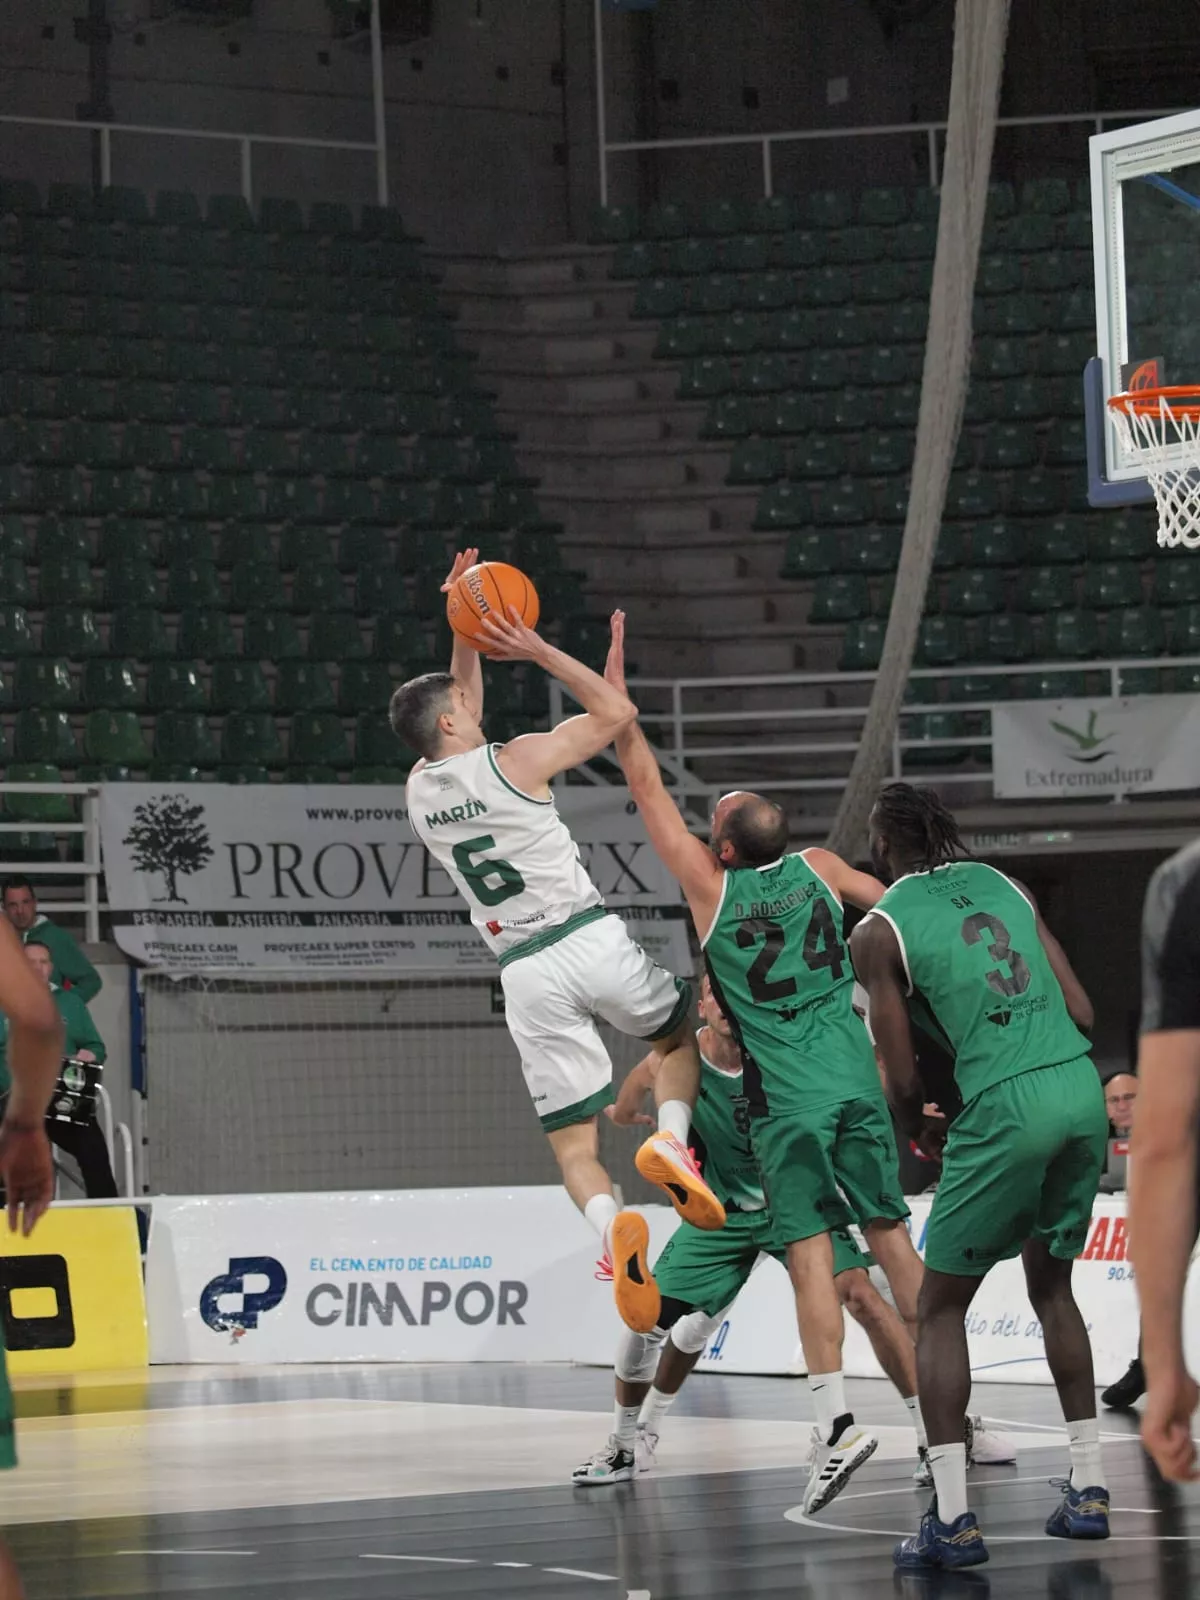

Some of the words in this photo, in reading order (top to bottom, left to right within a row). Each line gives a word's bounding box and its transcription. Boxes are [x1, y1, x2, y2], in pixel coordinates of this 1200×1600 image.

[1023, 765, 1154, 788] Extremadura
[424, 798, 488, 829] MARÍN
[451, 833, 526, 908] 6
[950, 895, 975, 909] SA
[734, 897, 847, 1005] 24
[960, 911, 1032, 998] 3
[310, 1258, 327, 1272] EL
[331, 1257, 404, 1271] CEMENTO
[408, 1256, 428, 1271] DE
[430, 1255, 492, 1270] CALIDAD
[305, 1280, 529, 1327] CIMPOR
[991, 1311, 1021, 1337] del
